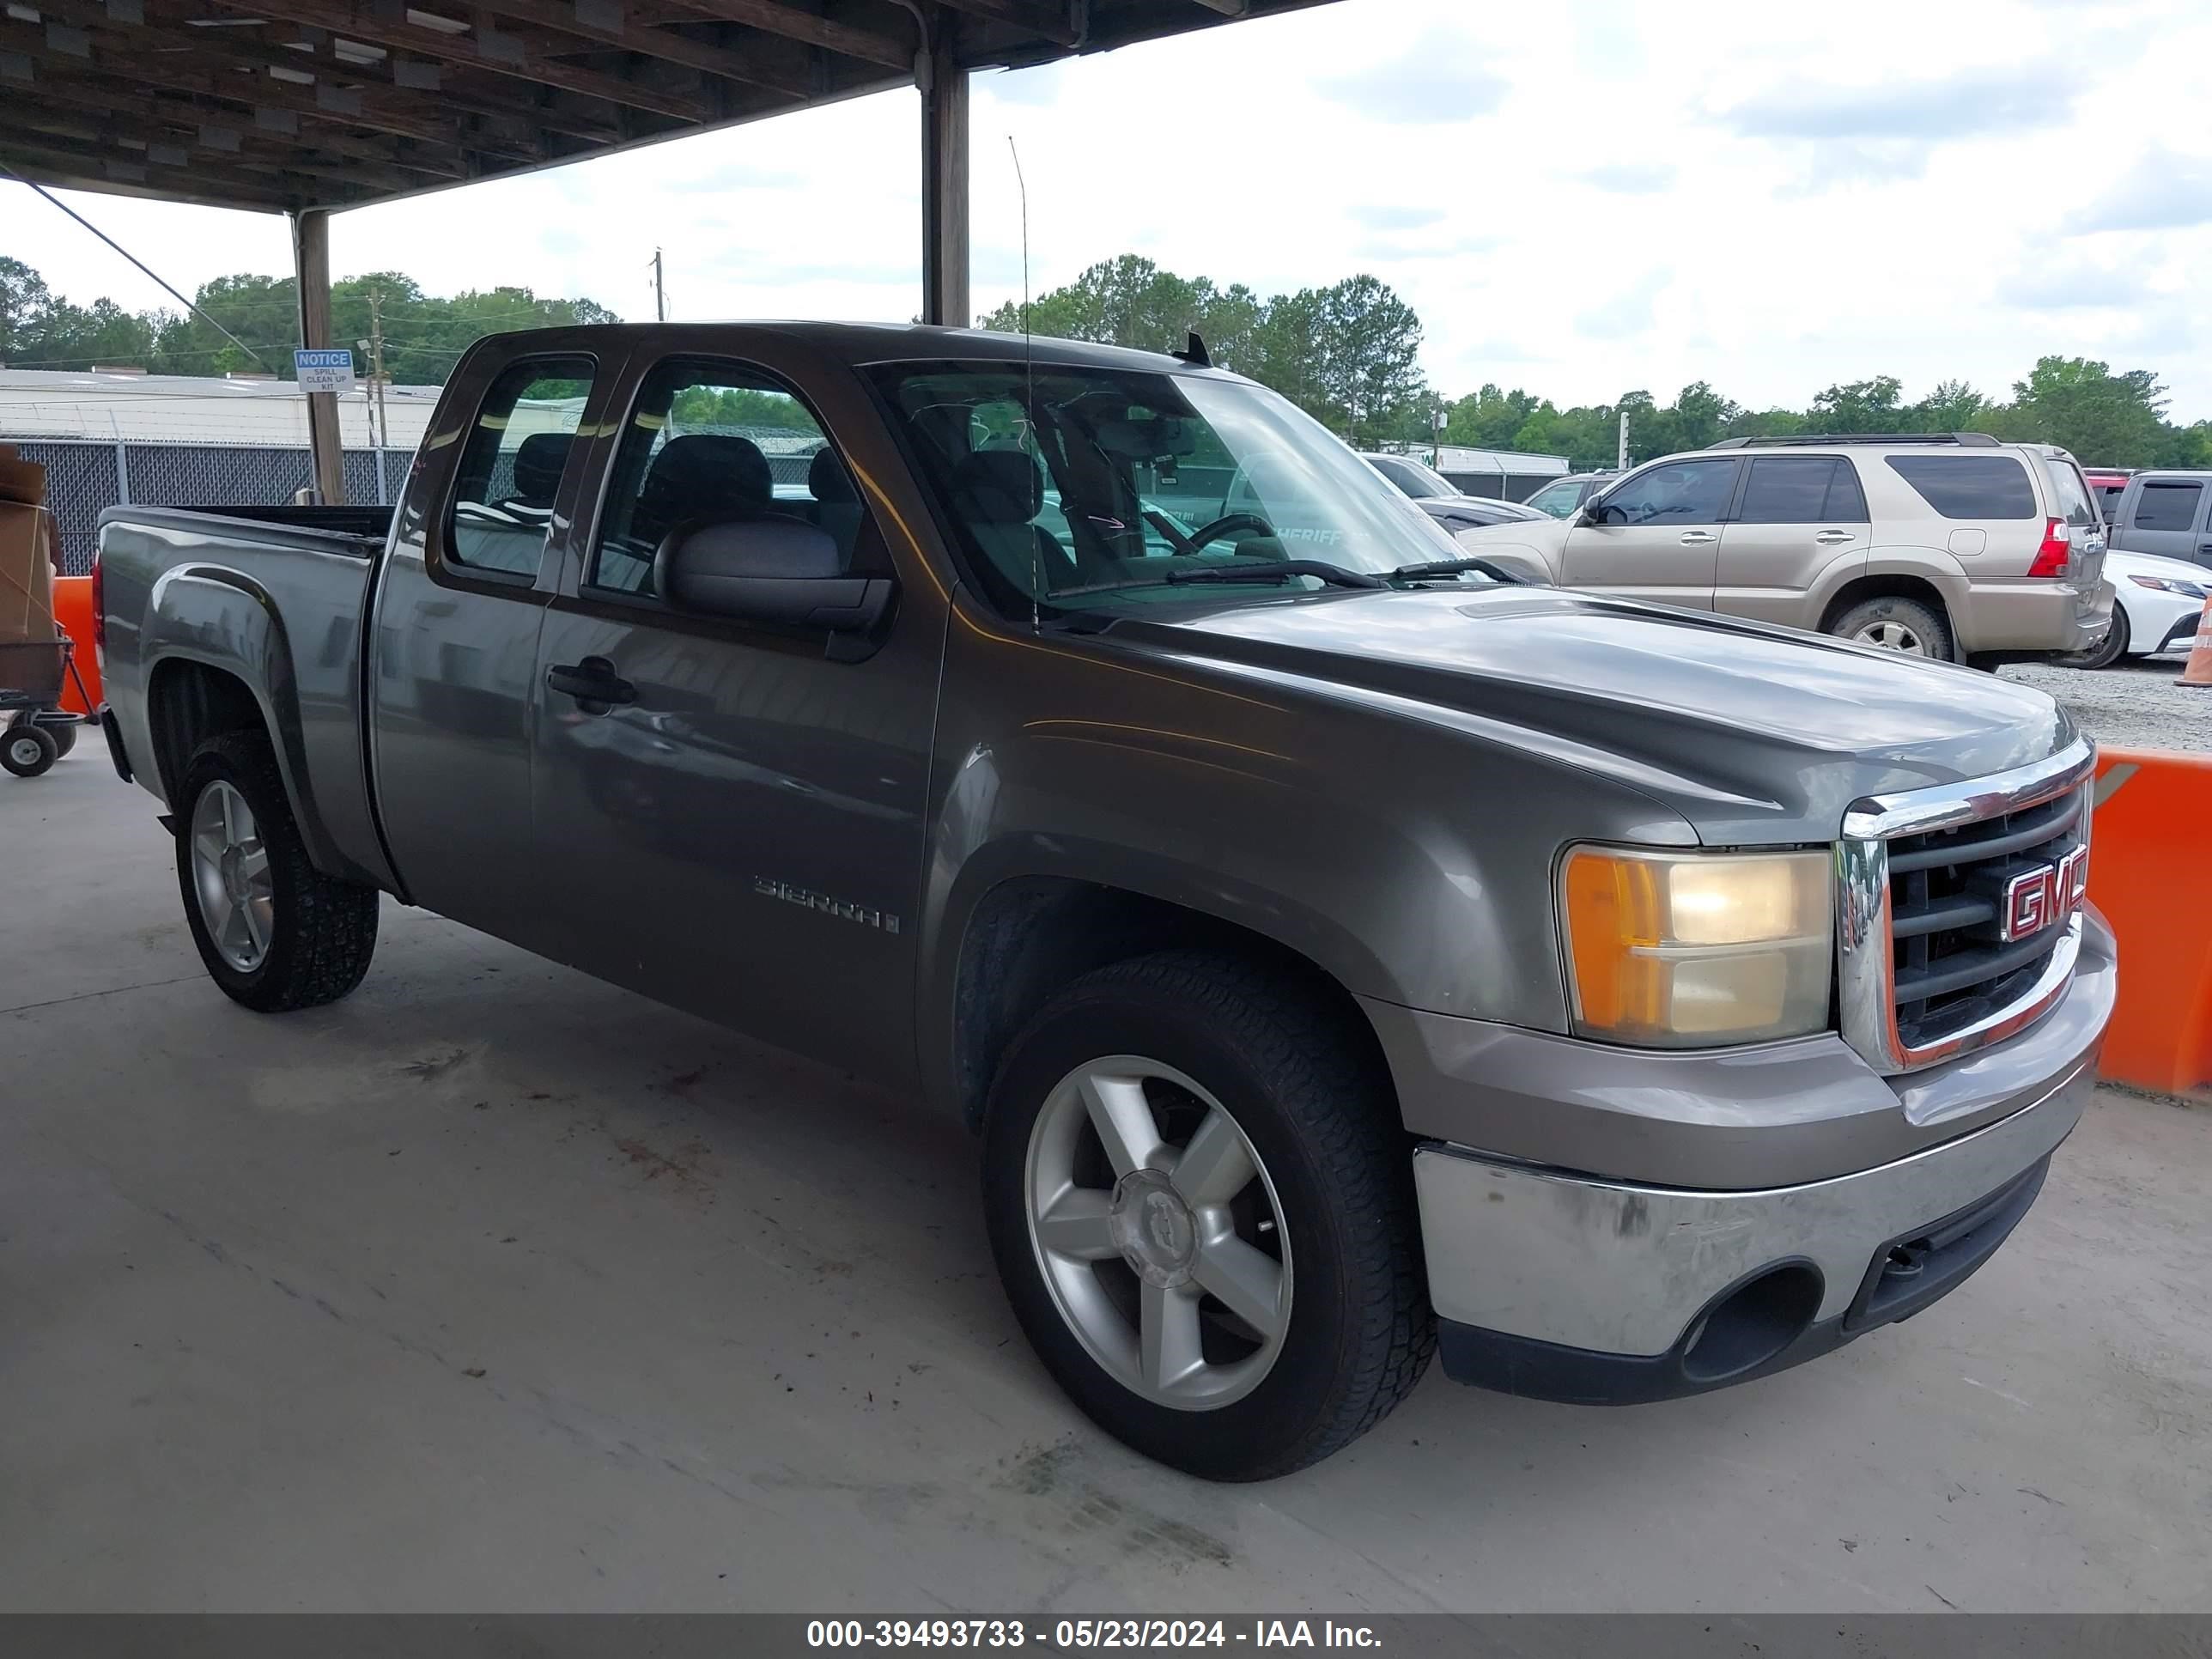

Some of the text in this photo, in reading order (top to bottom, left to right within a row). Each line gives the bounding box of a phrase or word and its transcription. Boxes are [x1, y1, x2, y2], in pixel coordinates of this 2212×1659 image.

[300, 353, 348, 365] NOTICE
[1276, 527, 1342, 546] HERIFF
[755, 875, 879, 928] SIERRA
[2004, 844, 2087, 942] GMC
